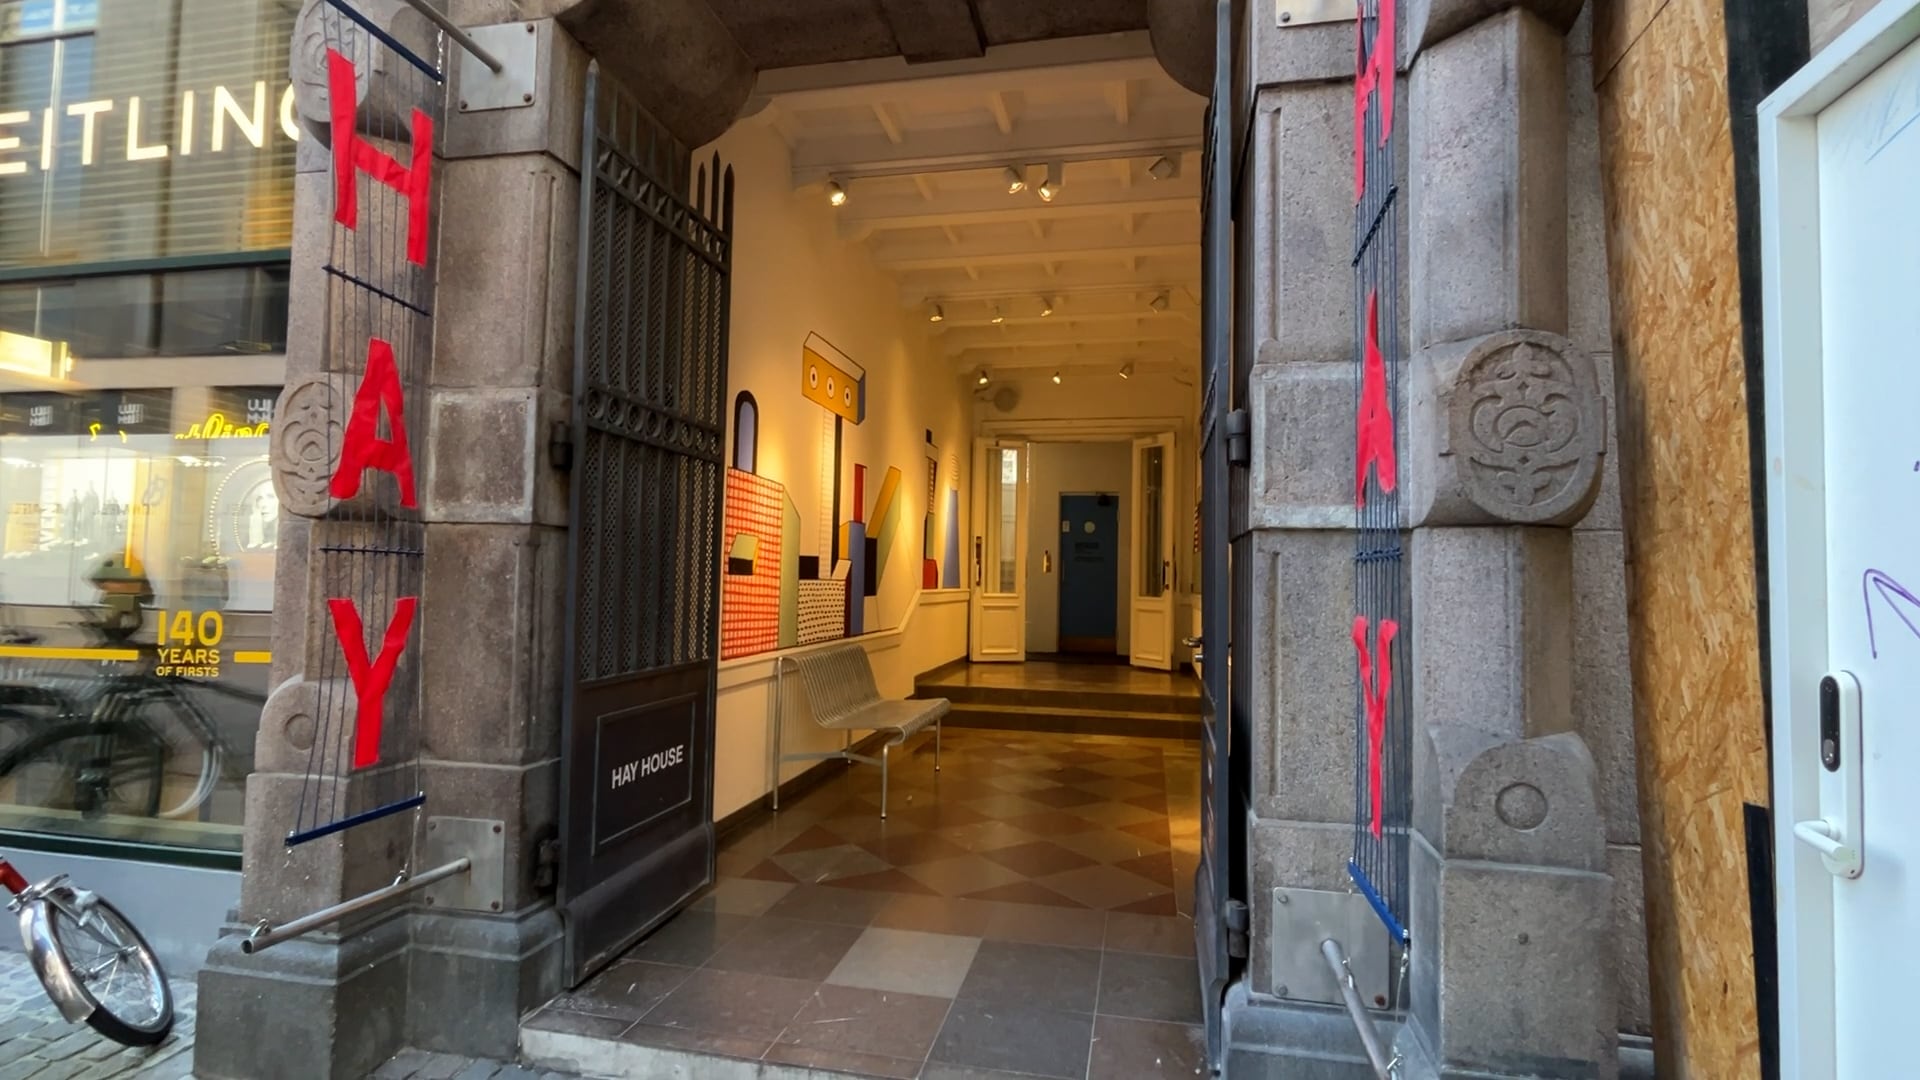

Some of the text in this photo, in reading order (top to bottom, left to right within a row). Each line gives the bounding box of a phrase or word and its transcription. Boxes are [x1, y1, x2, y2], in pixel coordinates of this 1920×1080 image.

[327, 48, 433, 770] HAY
[157, 610, 223, 646] 140
[155, 666, 219, 677] OF FIRSTS
[157, 648, 220, 664] YEARS
[611, 744, 684, 789] HAY HOUSE
